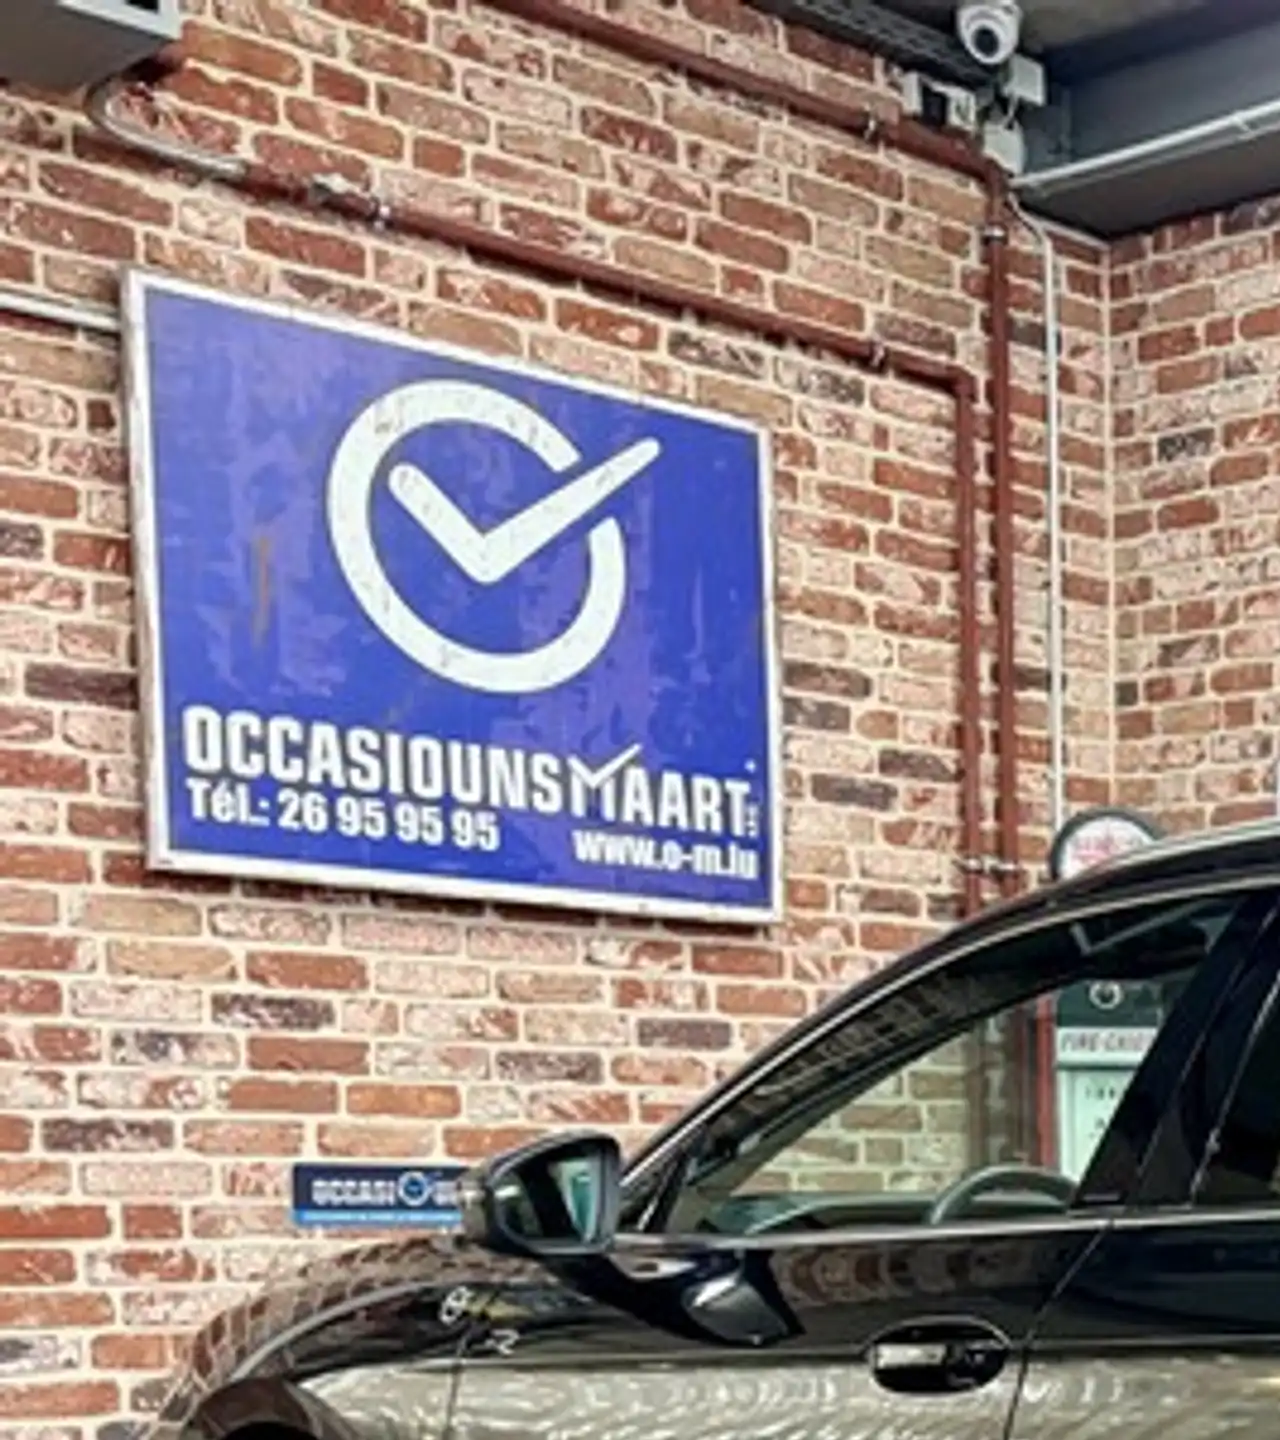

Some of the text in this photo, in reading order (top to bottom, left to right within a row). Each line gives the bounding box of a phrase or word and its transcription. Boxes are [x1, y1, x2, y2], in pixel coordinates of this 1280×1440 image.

[276, 787, 328, 832] 26
[335, 796, 387, 838] 95
[393, 801, 444, 846] 95
[450, 808, 500, 852] 95
